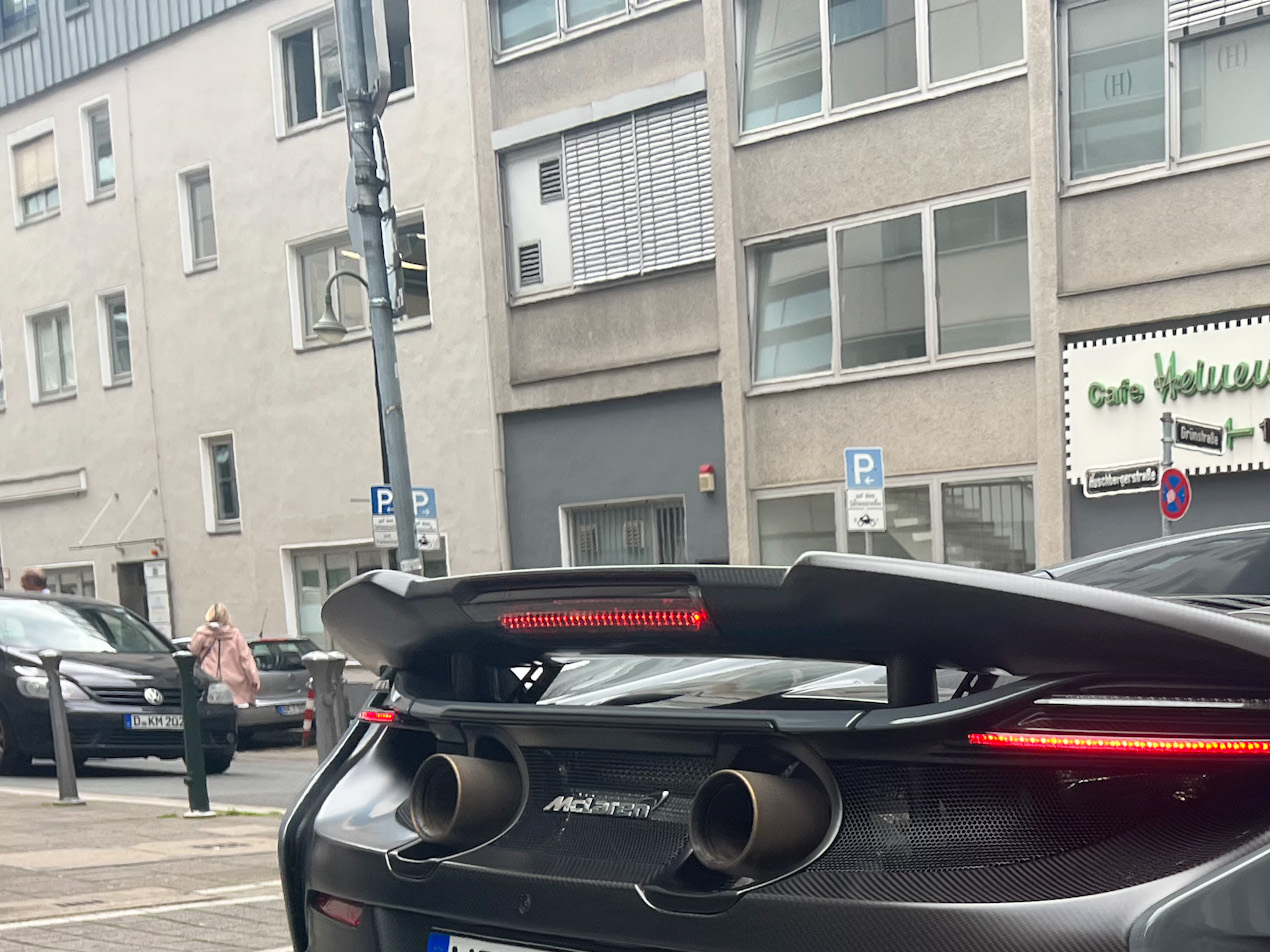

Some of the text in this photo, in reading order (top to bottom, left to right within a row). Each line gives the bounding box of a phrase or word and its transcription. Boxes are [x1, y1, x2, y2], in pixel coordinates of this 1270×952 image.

[1103, 69, 1133, 98] (H)
[1180, 425, 1218, 445] Grünstraße
[853, 453, 875, 485] P
[377, 489, 393, 514] P
[411, 490, 429, 516] P
[543, 795, 652, 818] McLaren
